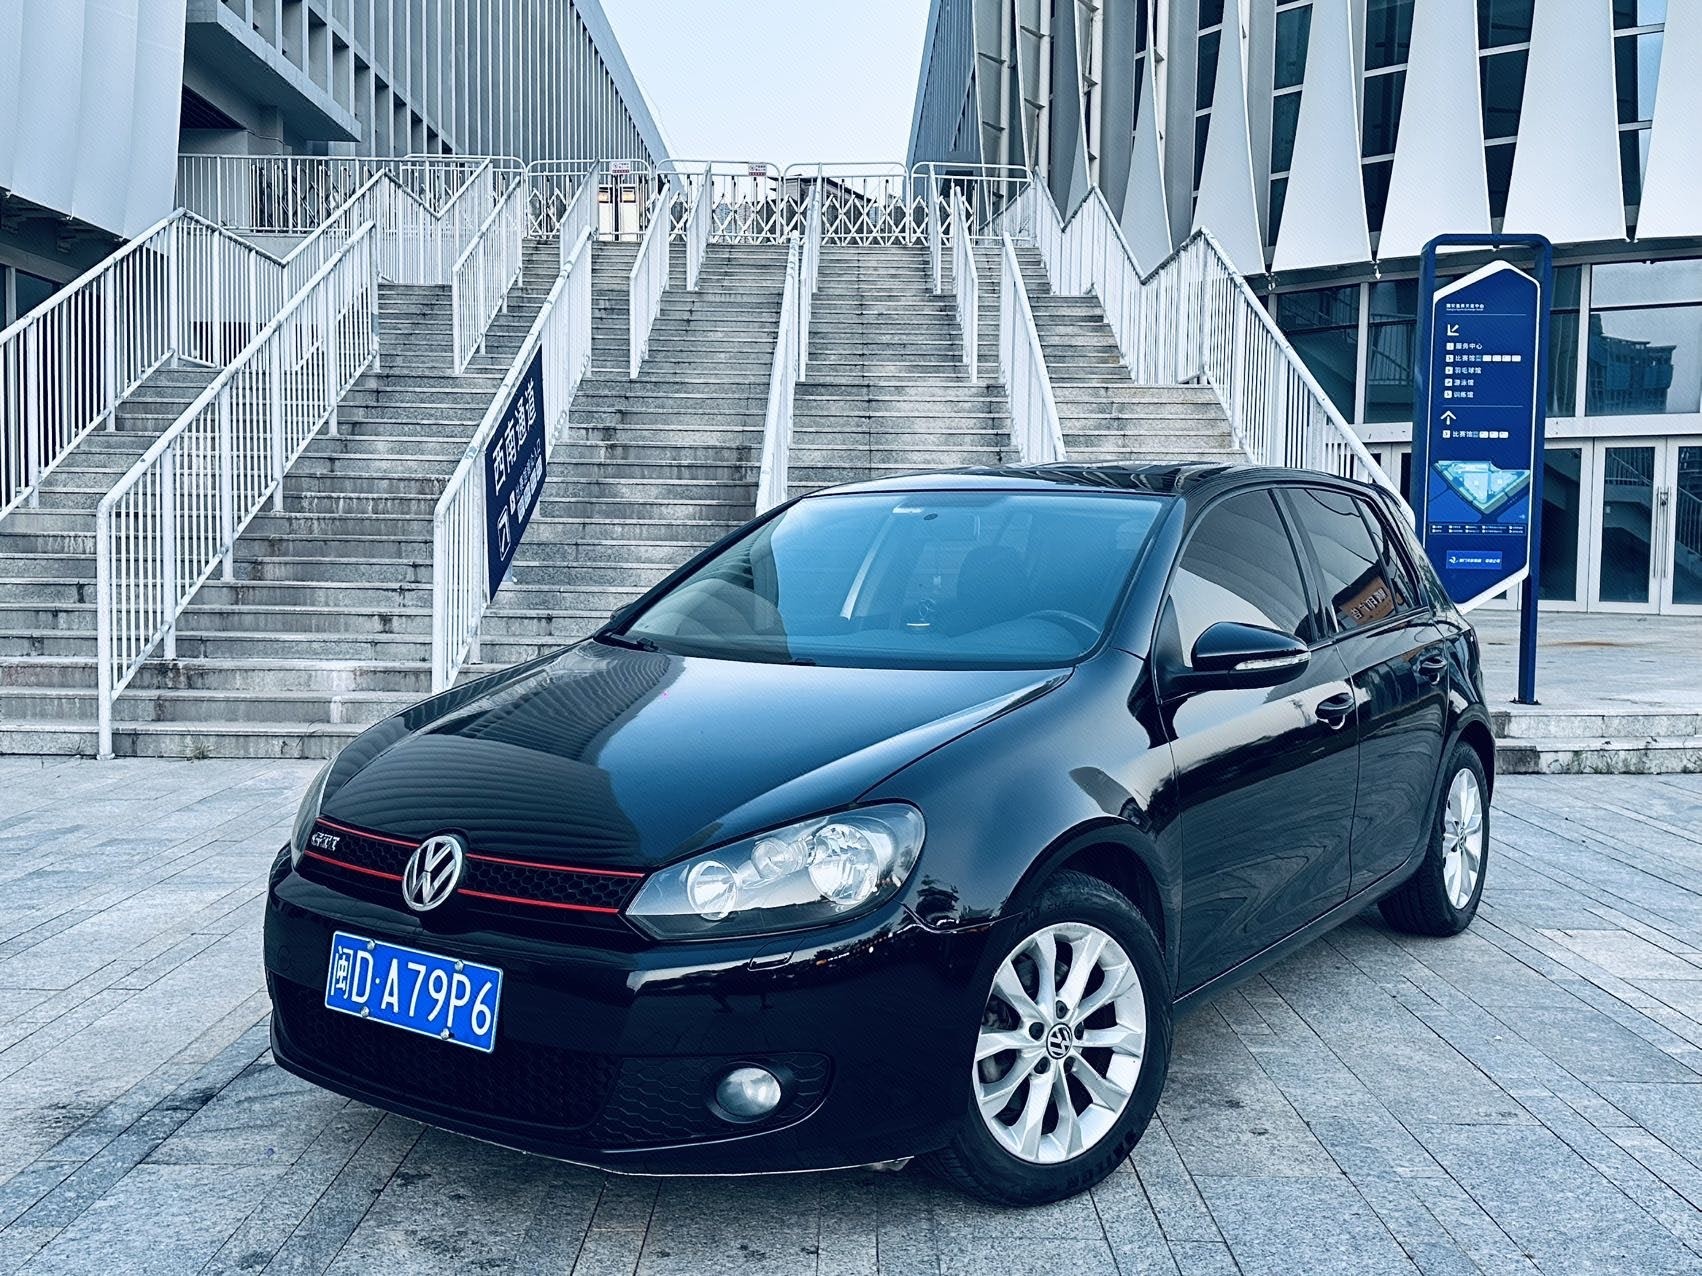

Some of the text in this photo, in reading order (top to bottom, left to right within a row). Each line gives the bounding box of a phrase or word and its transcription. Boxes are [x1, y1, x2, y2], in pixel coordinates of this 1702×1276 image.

[1455, 342, 1483, 350] 服务中心
[492, 377, 537, 496] 西南通道
[311, 831, 341, 852] GTI
[330, 945, 494, 1036] 闽D·A79P6
